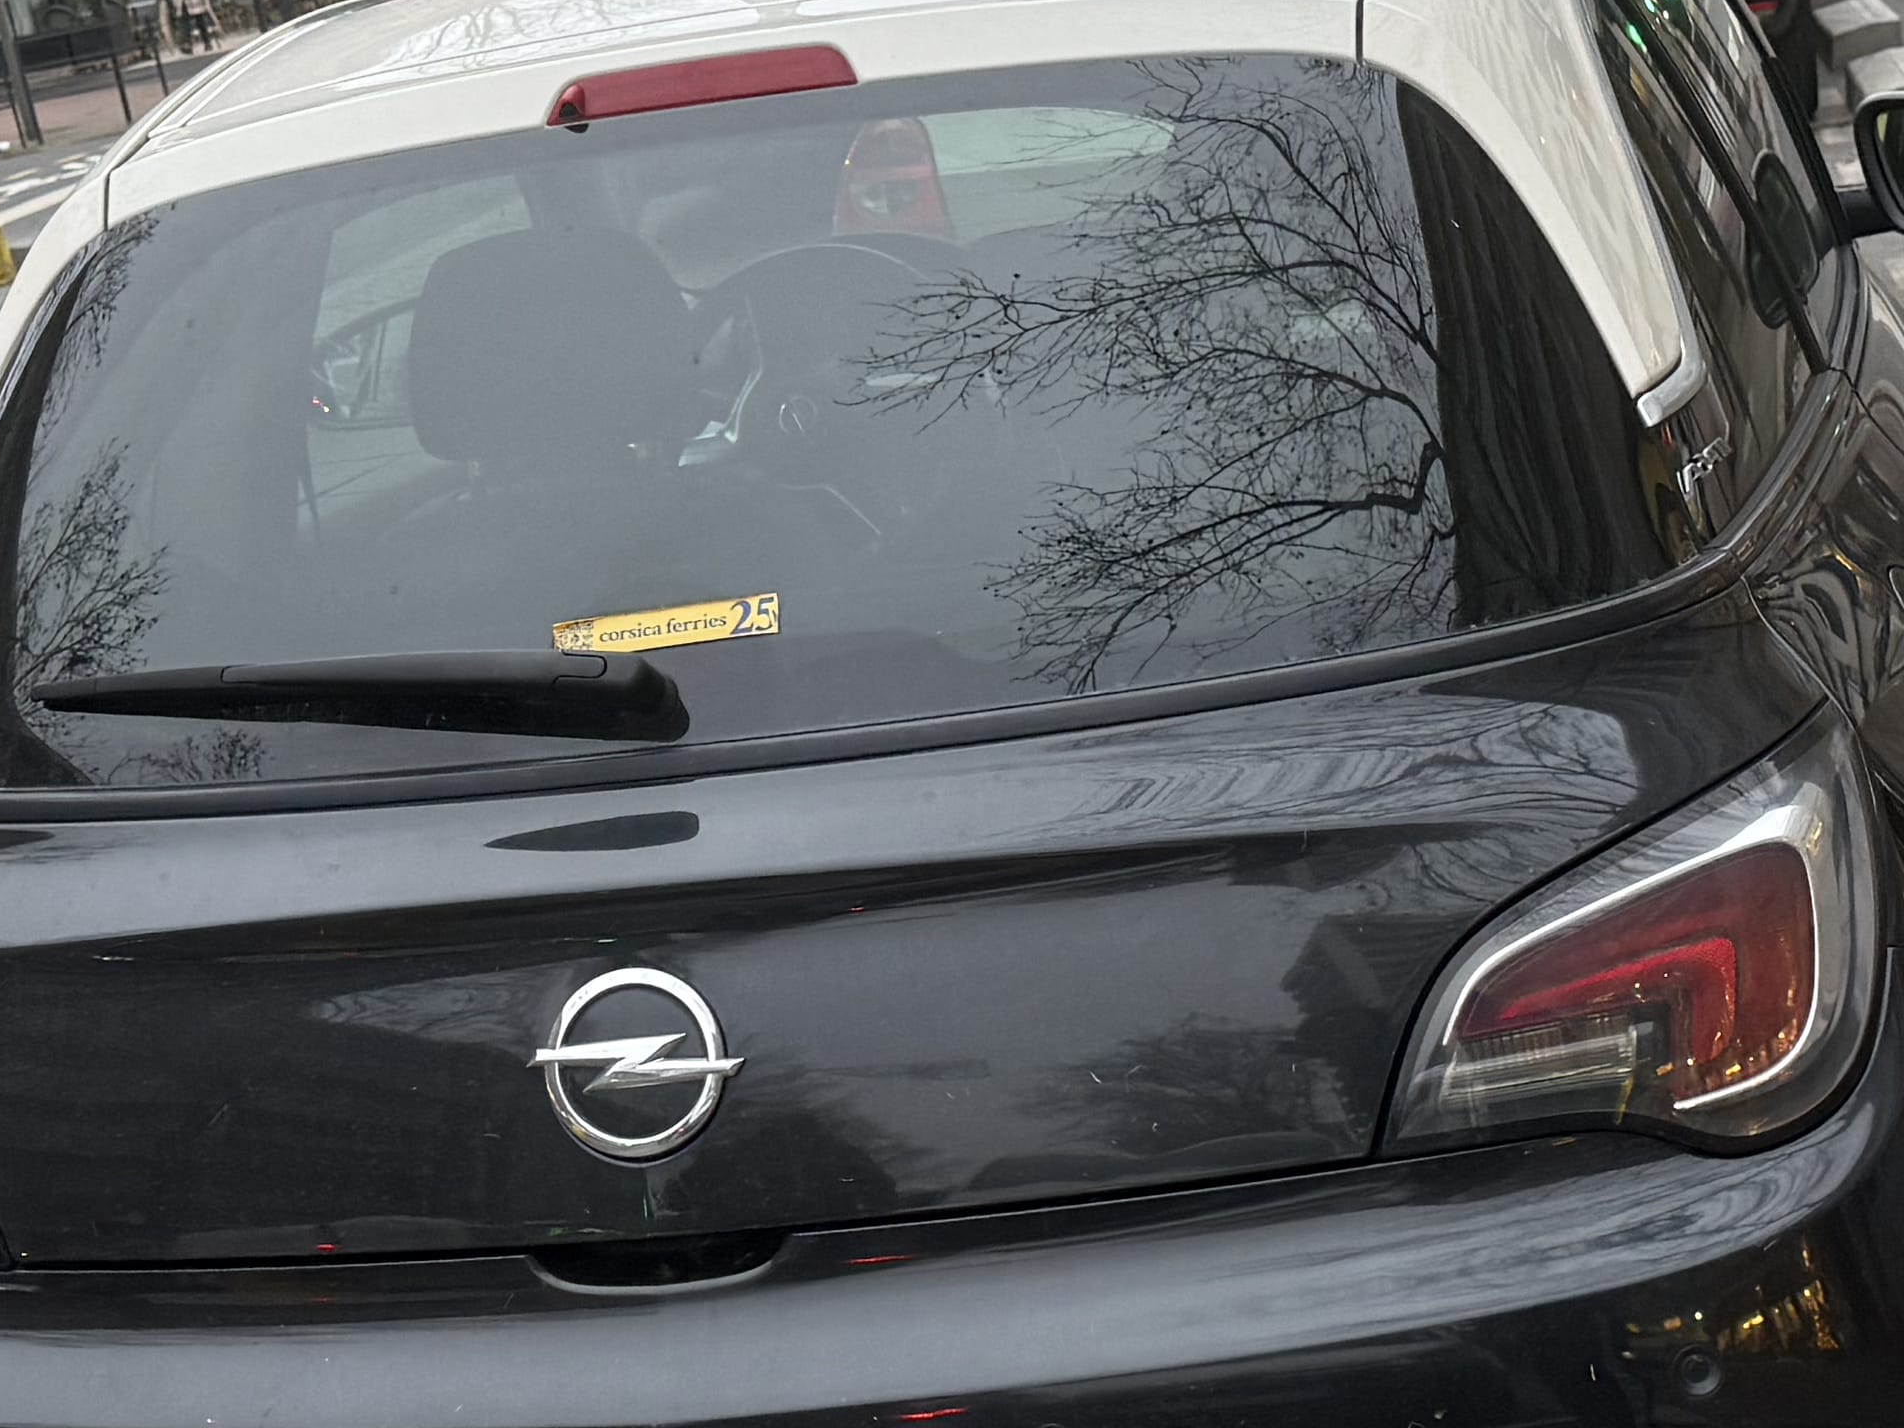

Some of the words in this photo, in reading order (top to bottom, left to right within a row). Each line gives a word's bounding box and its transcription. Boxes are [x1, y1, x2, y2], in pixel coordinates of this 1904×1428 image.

[599, 621, 662, 643] corsica
[666, 613, 728, 635] ferries
[729, 595, 776, 637] 25
